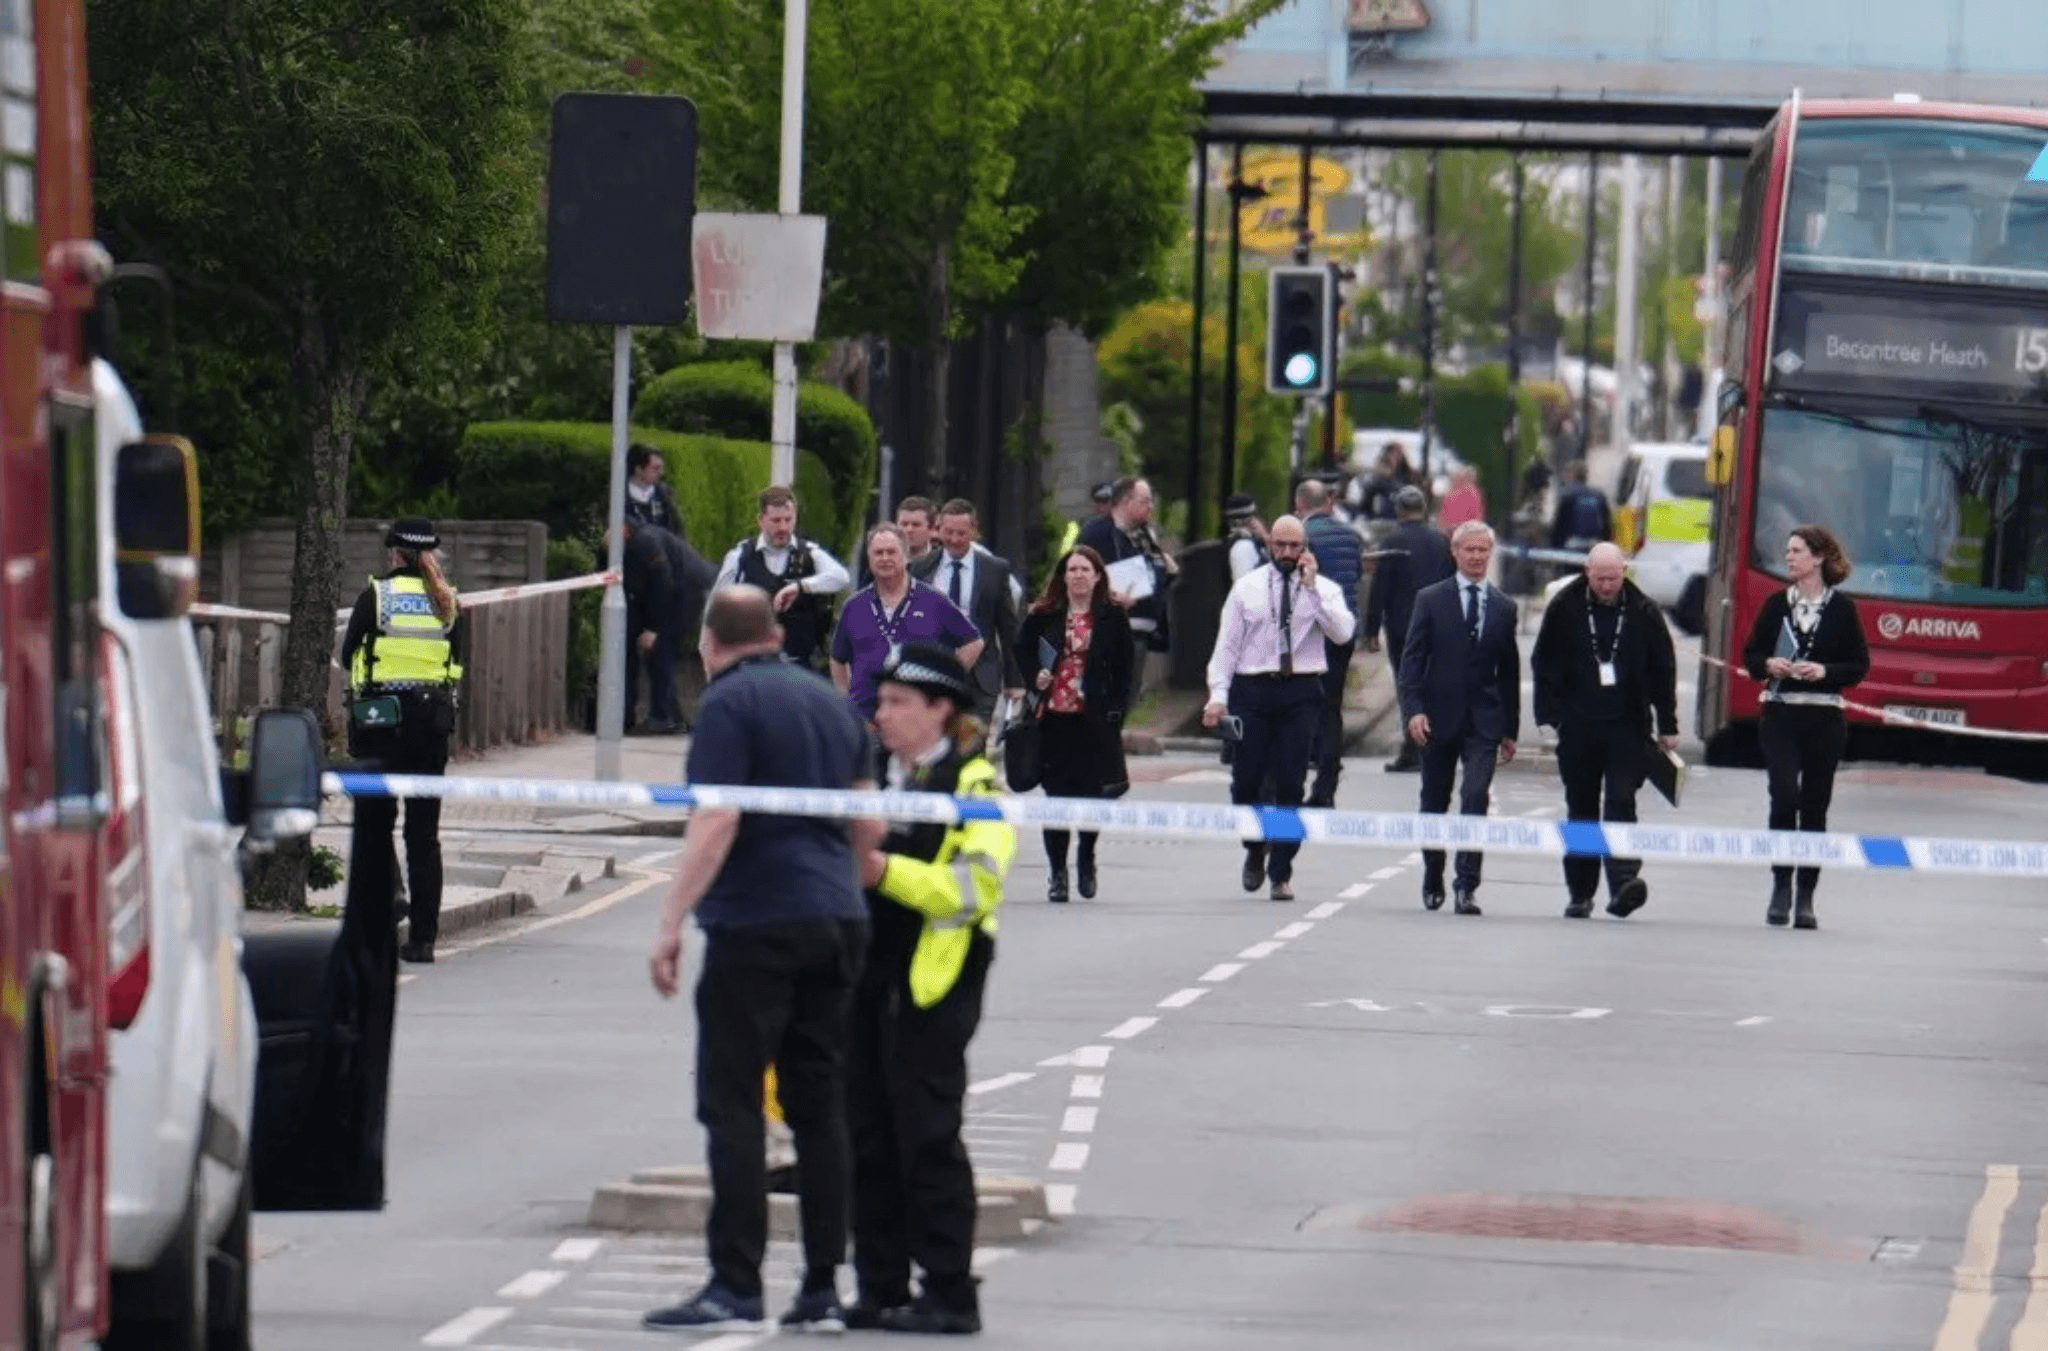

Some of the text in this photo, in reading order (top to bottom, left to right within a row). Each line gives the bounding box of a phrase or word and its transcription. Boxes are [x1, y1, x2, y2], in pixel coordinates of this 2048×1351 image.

[1825, 334, 1989, 368] Becontree Heath
[390, 600, 434, 615] POLIC
[1905, 618, 1981, 640] ARRIVA
